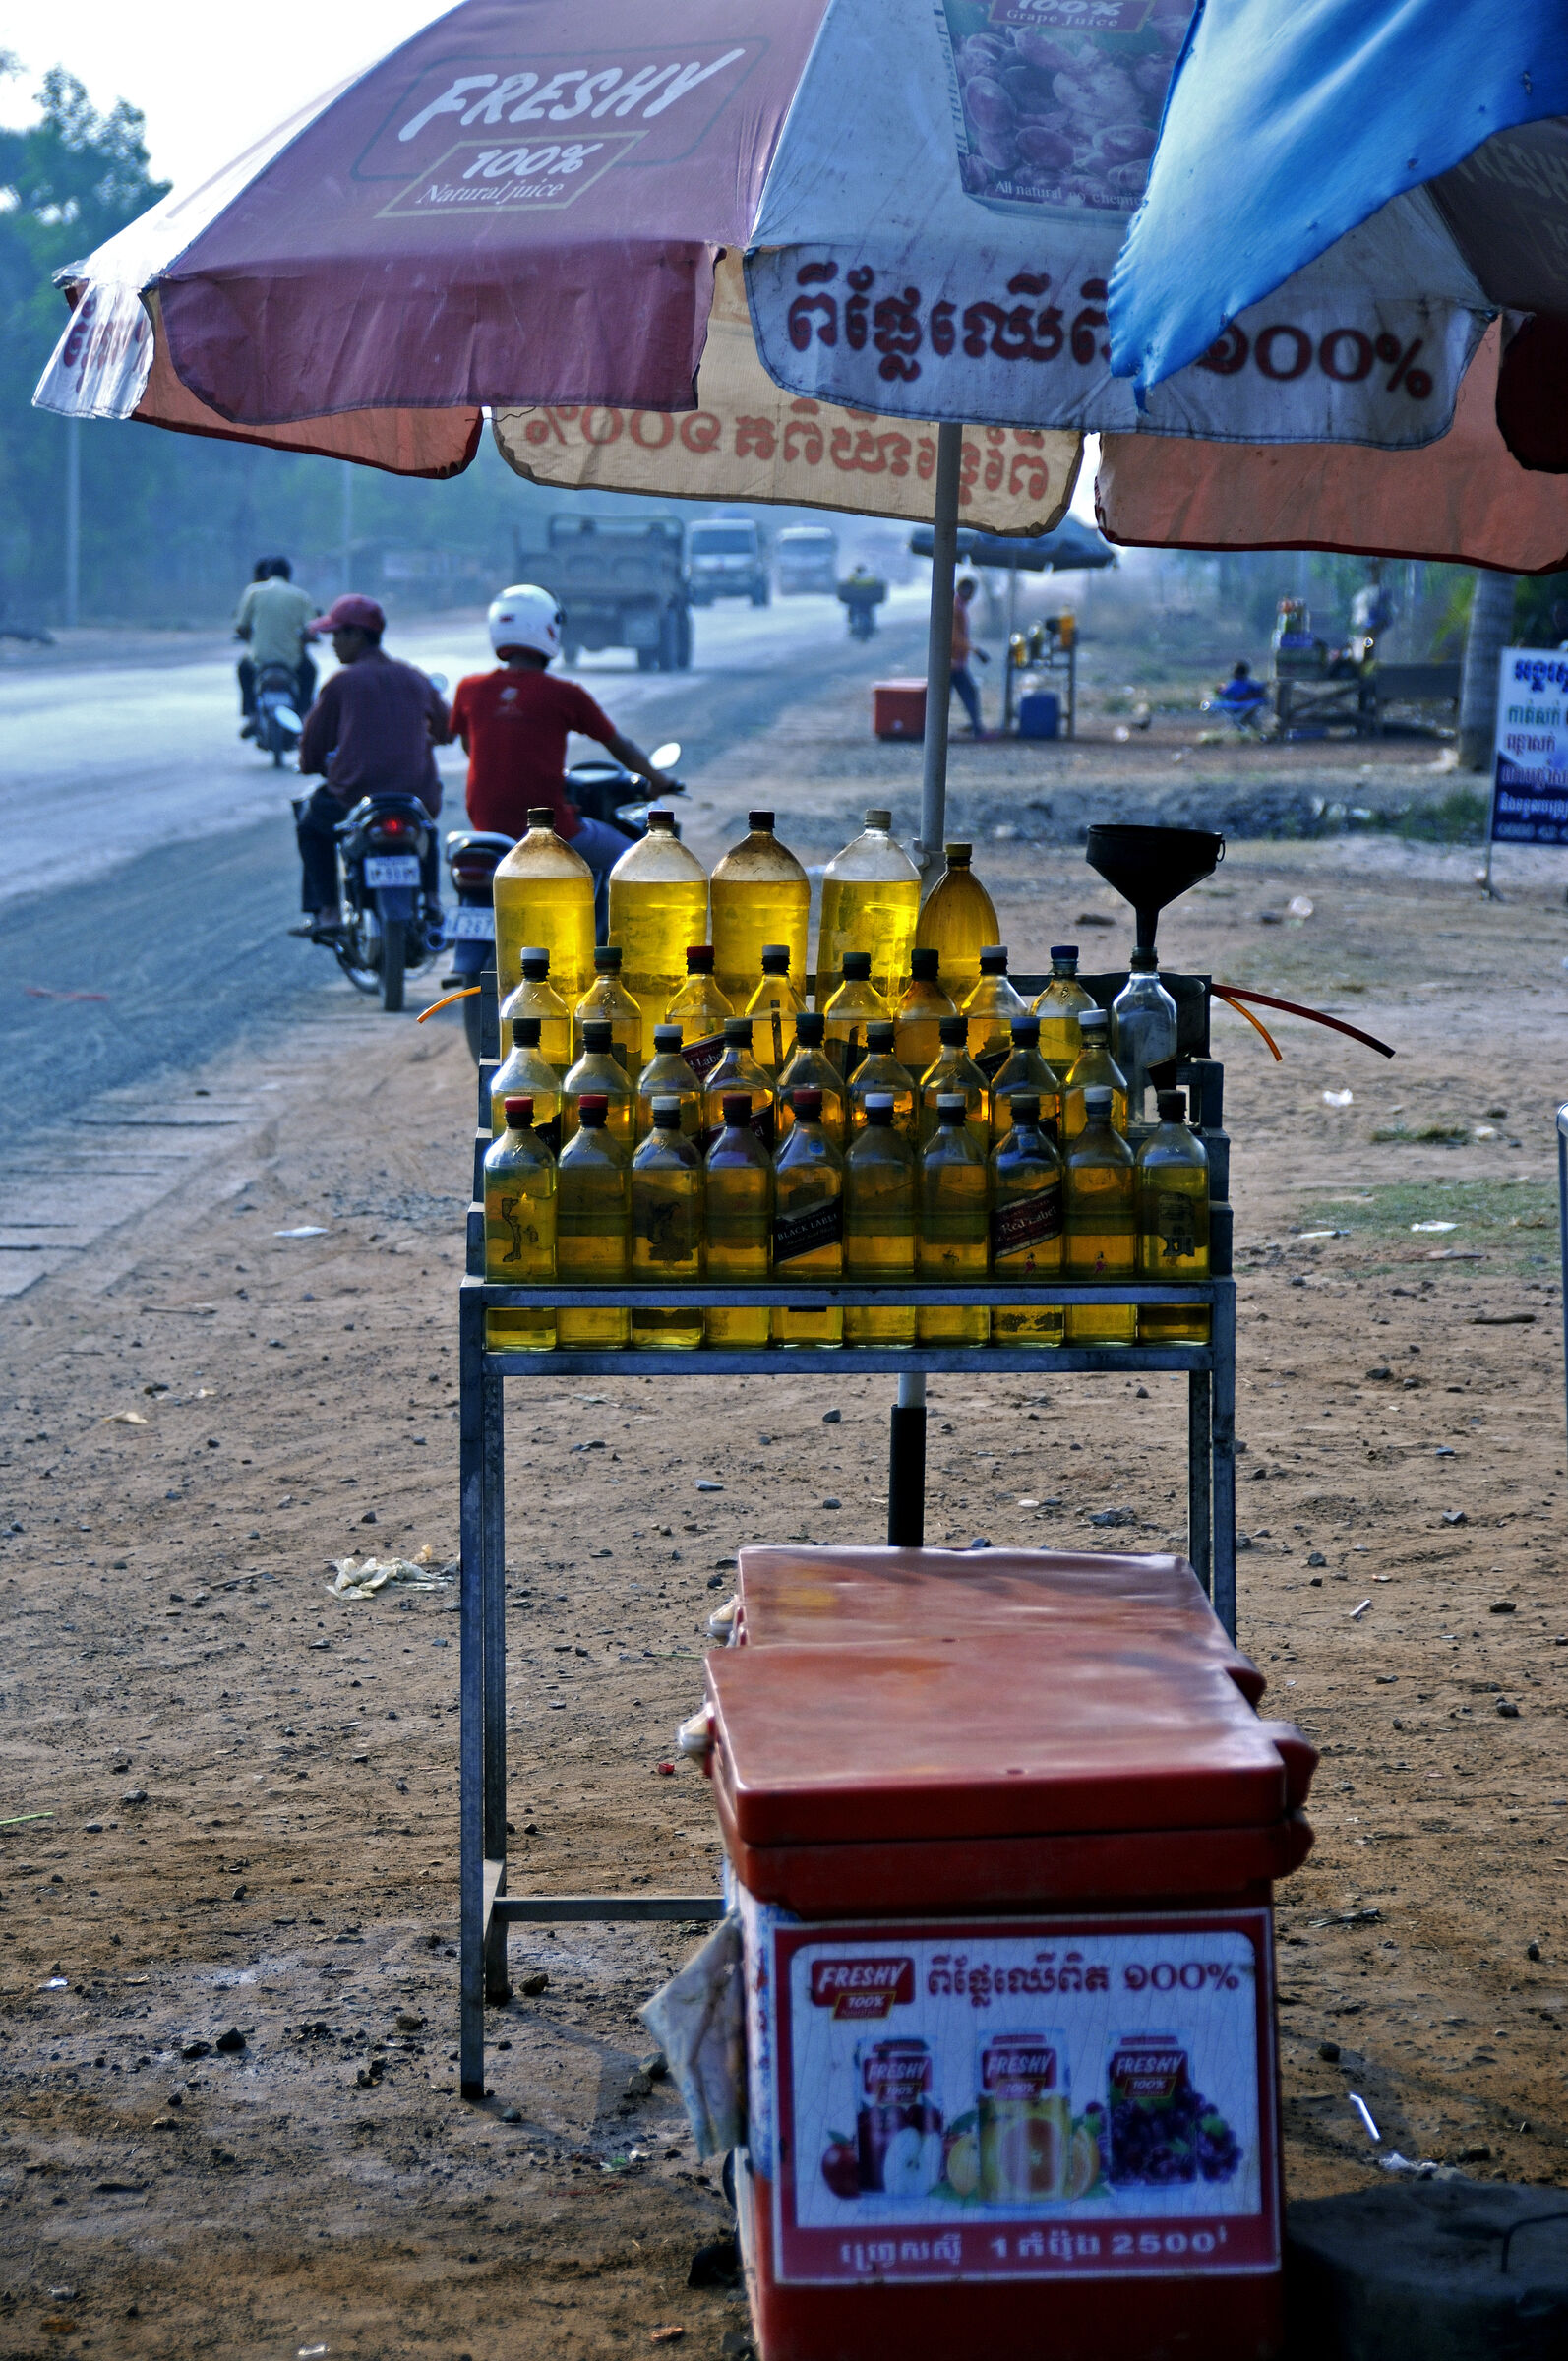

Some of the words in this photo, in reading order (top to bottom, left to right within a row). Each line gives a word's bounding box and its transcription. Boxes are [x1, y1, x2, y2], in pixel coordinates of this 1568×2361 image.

[1006, 9, 1058, 25] Grape
[398, 48, 746, 142] FRESHY
[462, 143, 604, 179] 100%
[415, 178, 508, 205] Natural
[496, 179, 565, 206] juice
[995, 180, 1012, 194] All
[1016, 185, 1062, 199] natural
[777, 1224, 809, 1241] BLACK
[999, 1217, 1027, 1235] Red
[818, 1960, 910, 1994] FRESHY
[848, 1995, 885, 2008] 100%
[867, 2059, 929, 2084] FRESHY
[986, 2052, 1054, 2079] FRESHY
[1116, 2053, 1184, 2078] FRESHY
[1132, 2079, 1168, 2090] 100%
[991, 2237, 1008, 2258] 1
